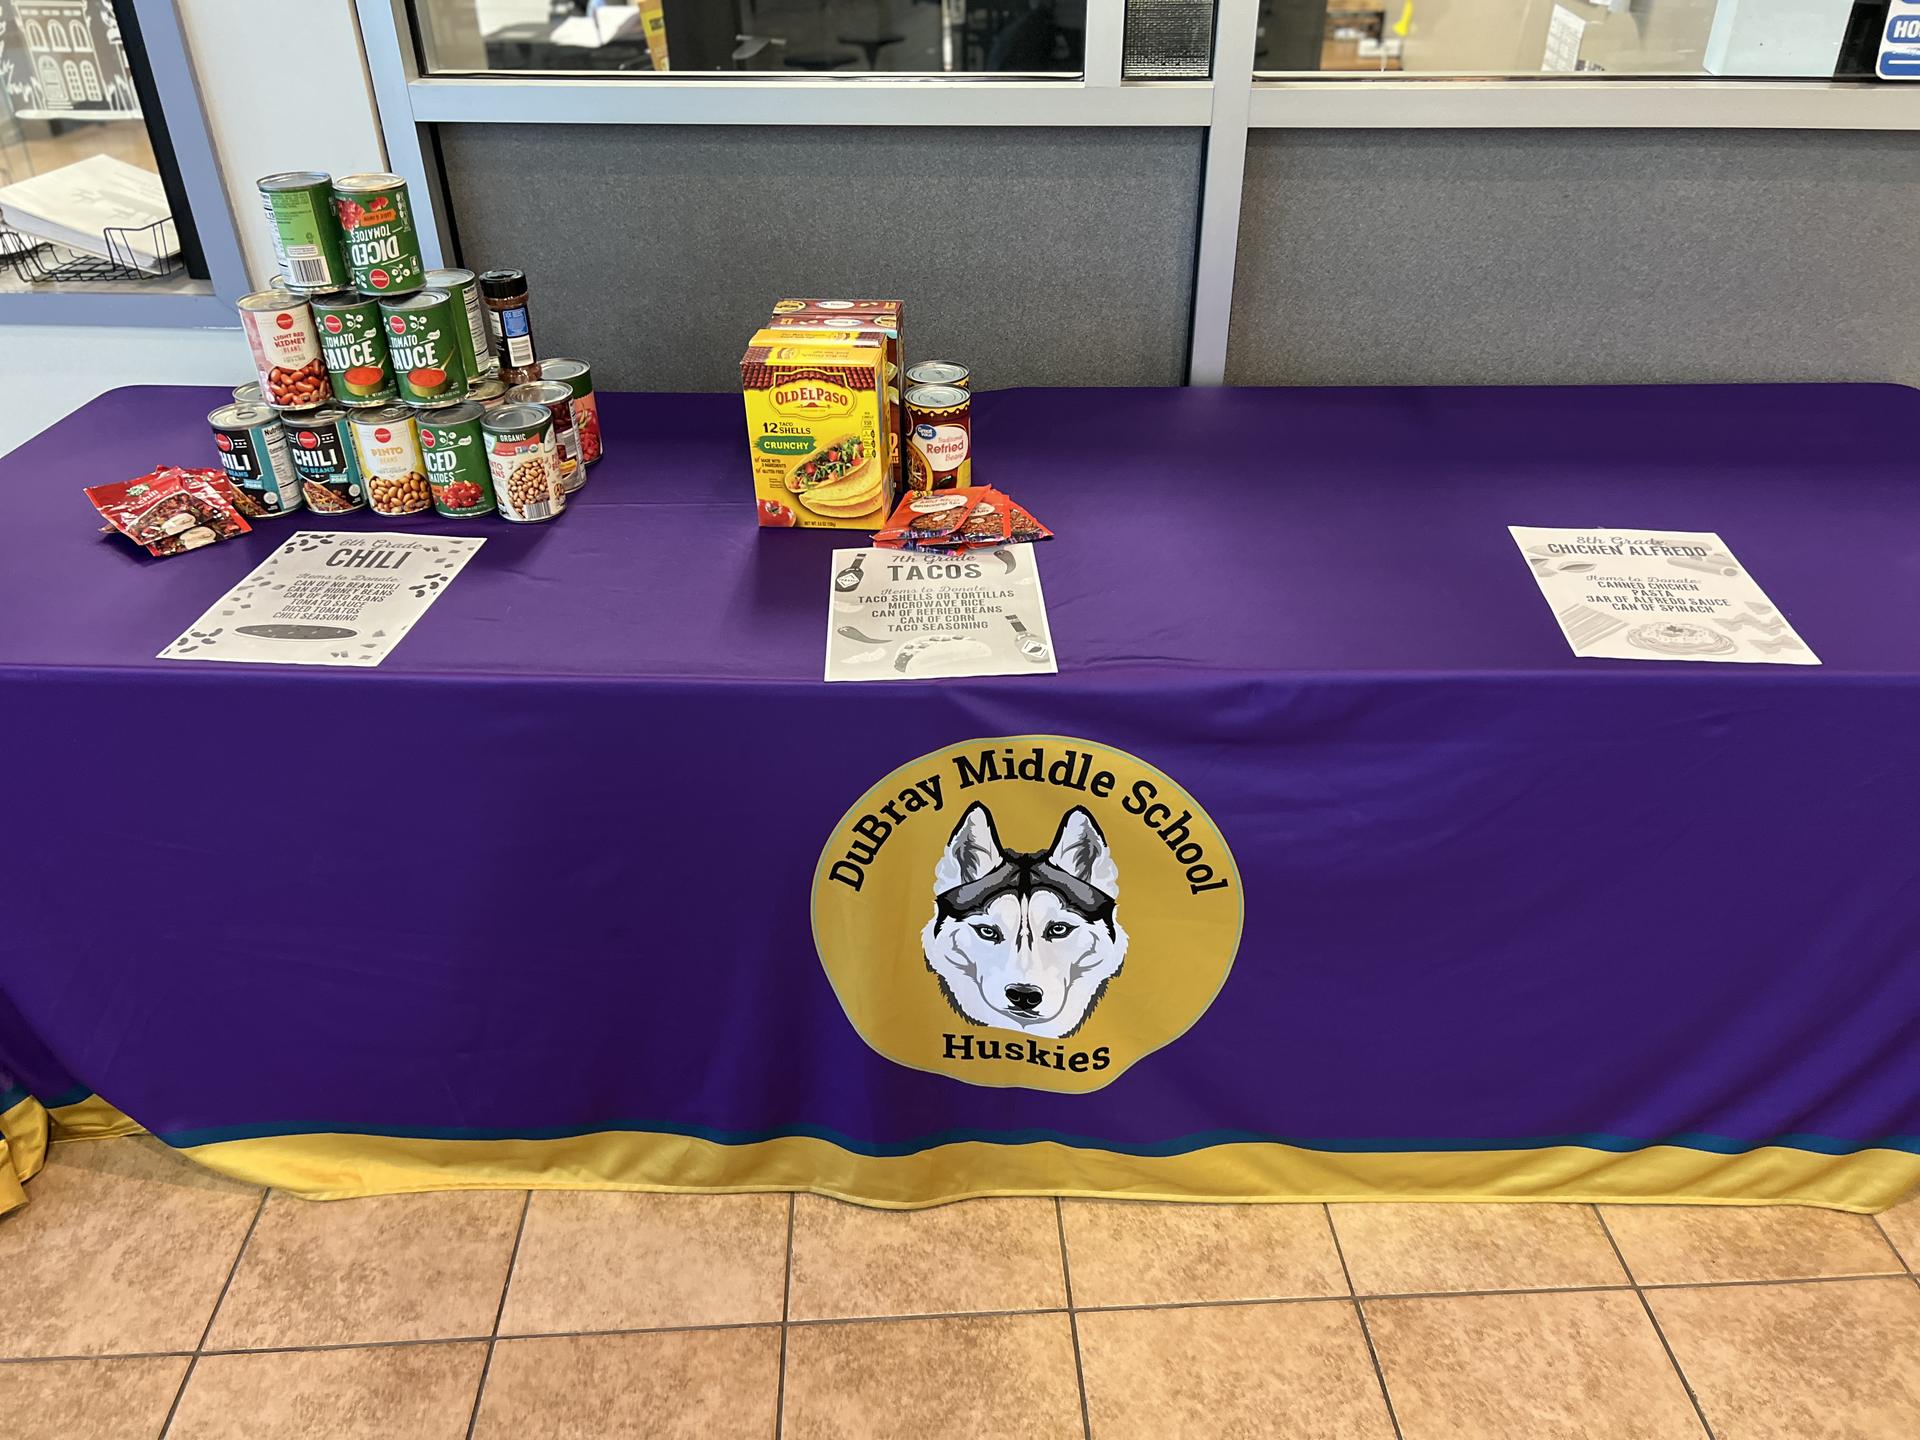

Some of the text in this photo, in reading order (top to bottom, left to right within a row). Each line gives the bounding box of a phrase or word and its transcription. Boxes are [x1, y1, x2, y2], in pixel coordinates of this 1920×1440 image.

[1893, 20, 1920, 38] HO
[351, 224, 391, 243] TOMATOES
[352, 235, 400, 266] DICED
[273, 333, 292, 341] LIGHT
[274, 337, 306, 348] KIDNEY
[325, 333, 355, 348] TOMATO
[390, 335, 418, 348] TOMATO
[775, 390, 798, 406] OLD
[800, 388, 815, 400] EL
[763, 422, 778, 433] 12
[500, 434, 527, 442] ORGANIC
[764, 441, 809, 450] CRUNCHY
[926, 440, 964, 454] Refried
[371, 447, 403, 456] PINTO
[293, 448, 338, 467] CHILI
[339, 539, 424, 551] 6th Grade
[1576, 536, 1665, 547] 8th Grade
[1548, 543, 1708, 557] CHICKEN ALFREDO
[326, 549, 412, 569] CHILI
[891, 554, 976, 564] 7th Grade
[887, 563, 982, 581] TACOS
[881, 586, 917, 595] Items
[1597, 581, 1700, 591] CANNED CHICKEN
[858, 590, 1015, 603] TACO SHELLS OR TORTILLAS
[1632, 589, 1674, 597] PASTA
[291, 598, 366, 608] TOMATO SAUCE
[888, 598, 985, 609] MICROWAVE RICE
[1634, 596, 1688, 605] ALFREDO
[1688, 598, 1732, 606] SAUCE
[917, 607, 961, 616] REFRIED
[965, 605, 1003, 614] BEANS
[1612, 603, 1715, 613] CAN OF SPINACH
[300, 612, 358, 621] SEASONING
[900, 614, 975, 624] CAN OF CORN
[888, 621, 988, 632] TACO SEASONING
[828, 748, 1229, 896] DuBray Middle School
[942, 1033, 1111, 1073] Huskies
